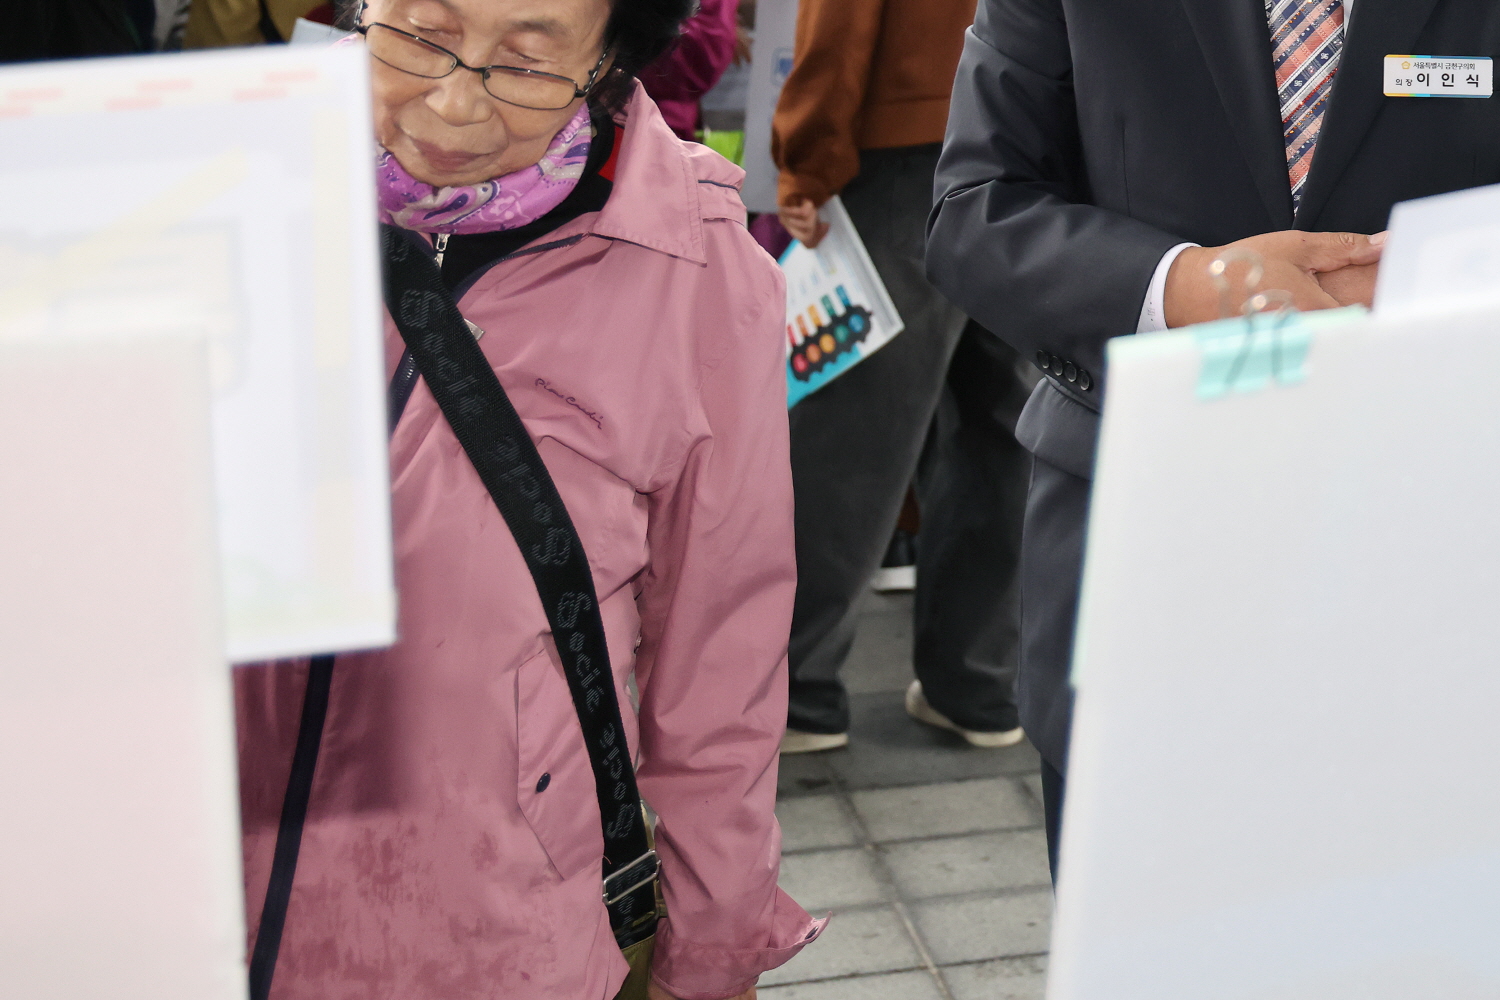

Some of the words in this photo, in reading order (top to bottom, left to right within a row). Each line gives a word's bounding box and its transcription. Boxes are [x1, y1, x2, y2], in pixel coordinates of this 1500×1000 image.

[1413, 62, 1444, 70] 서울특별시
[1445, 62, 1476, 70] 금천구의회
[1395, 78, 1413, 87] 의장
[1416, 73, 1479, 88] 이인식
